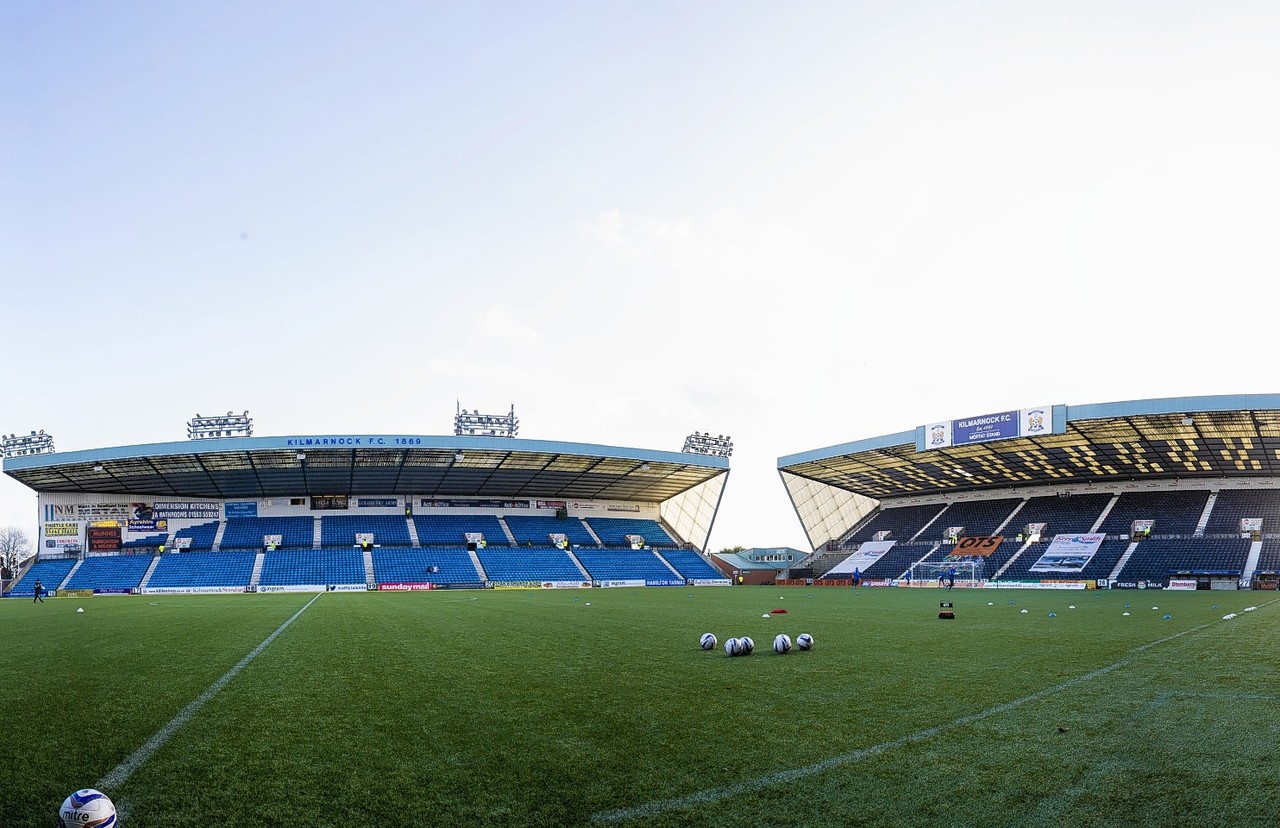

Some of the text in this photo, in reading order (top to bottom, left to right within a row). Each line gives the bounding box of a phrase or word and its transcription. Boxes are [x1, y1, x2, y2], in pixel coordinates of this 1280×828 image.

[958, 414, 1012, 429] KILMARNOCK F.C.
[287, 438, 362, 446] KILMARNOCK
[959, 537, 999, 549] QTS
[381, 583, 412, 591] sunday
[412, 582, 430, 590] mail
[62, 810, 90, 822] mitre
